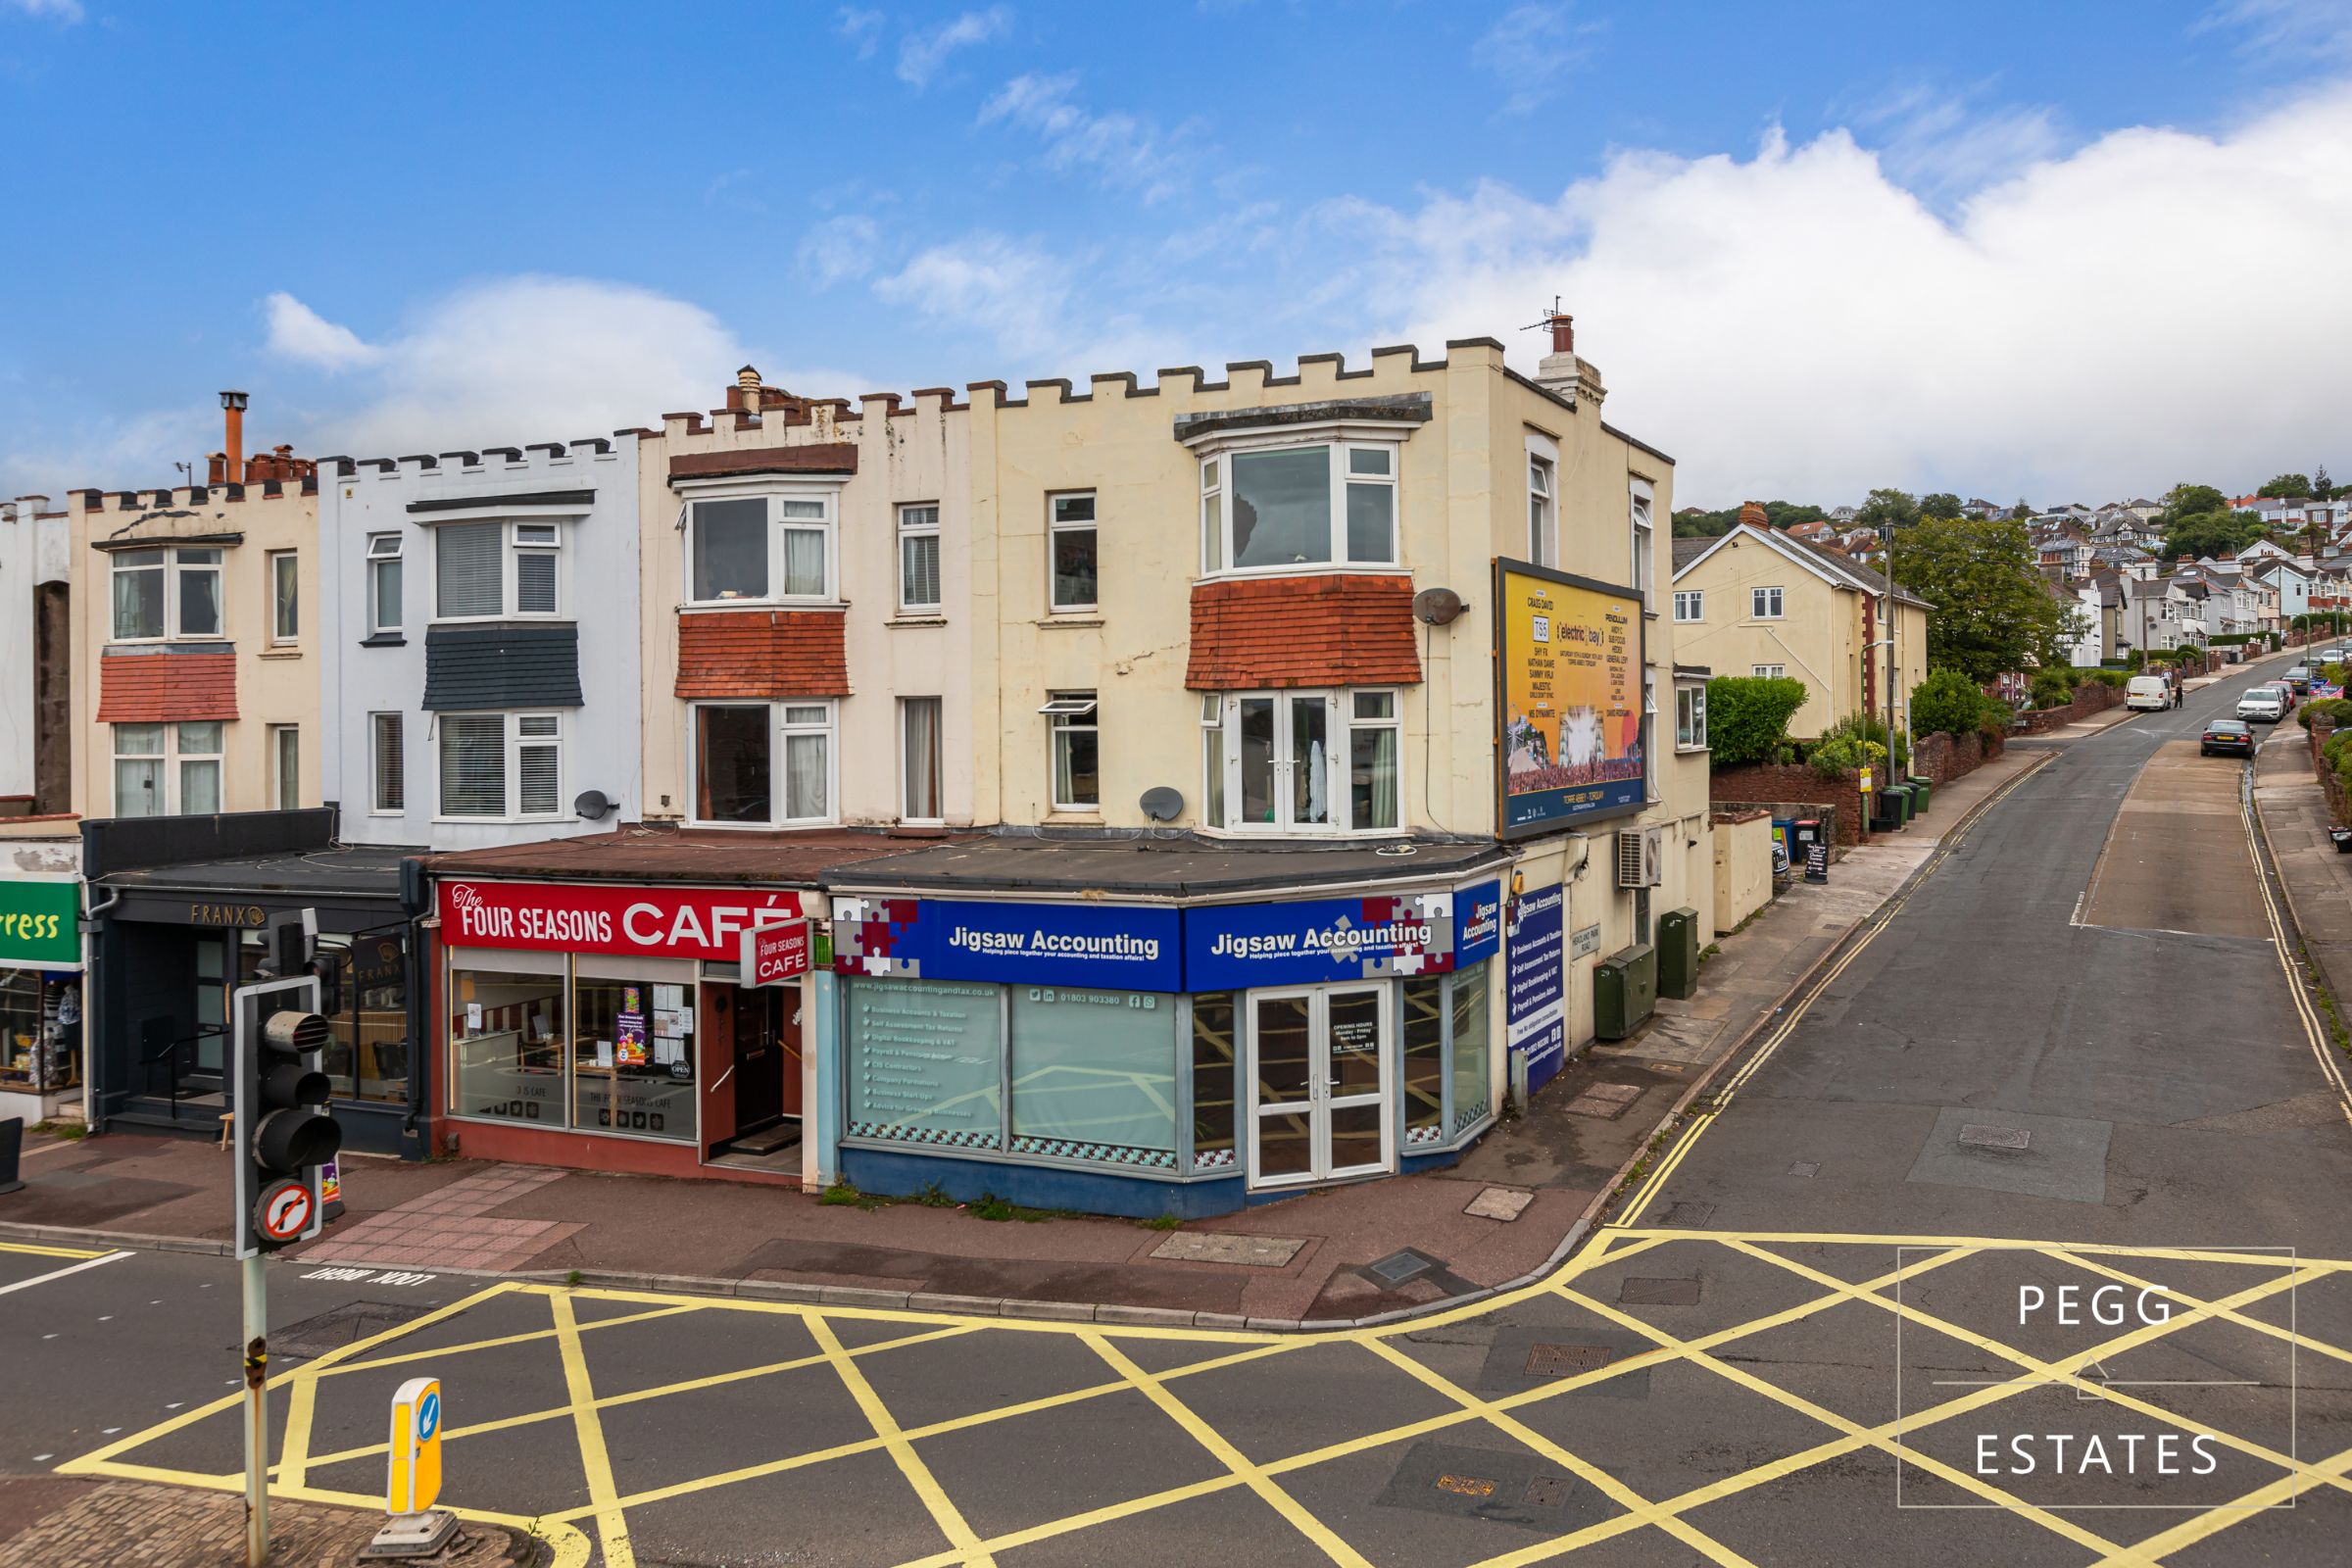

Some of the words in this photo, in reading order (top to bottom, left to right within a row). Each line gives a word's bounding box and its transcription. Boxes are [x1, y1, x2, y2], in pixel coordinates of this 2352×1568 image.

[1535, 620, 1546, 637] TS5
[1561, 623, 1584, 641] electric
[1589, 627, 1599, 646] bay
[453, 884, 483, 908] The
[1537, 893, 1562, 909] Accounting
[190, 906, 247, 926] FRANX
[1476, 903, 1497, 919] Jigsaw
[0, 913, 59, 940] ress
[461, 906, 514, 937] FOUR
[519, 907, 612, 943] SEASONS
[623, 895, 792, 948] CAFÉ
[1462, 918, 1496, 941] Accounting
[760, 943, 777, 956] FOUR
[777, 936, 805, 953] SEASONS
[949, 927, 1025, 952] Jigsaw
[1031, 930, 1158, 960] Accounting
[1211, 933, 1296, 958] Jigsaw
[1303, 922, 1432, 949] Accounting
[760, 950, 806, 978] CAFÉ
[853, 982, 995, 997] www.jigsawaccountingandtax.co.uk
[1060, 994, 1086, 1003] 01803
[1088, 996, 1119, 1004] 903380
[872, 1075, 901, 1085] Company
[530, 1088, 546, 1097] CAFE
[603, 1094, 623, 1103] FOR
[655, 1099, 671, 1108] CAFE
[366, 1271, 437, 1287] LOOK
